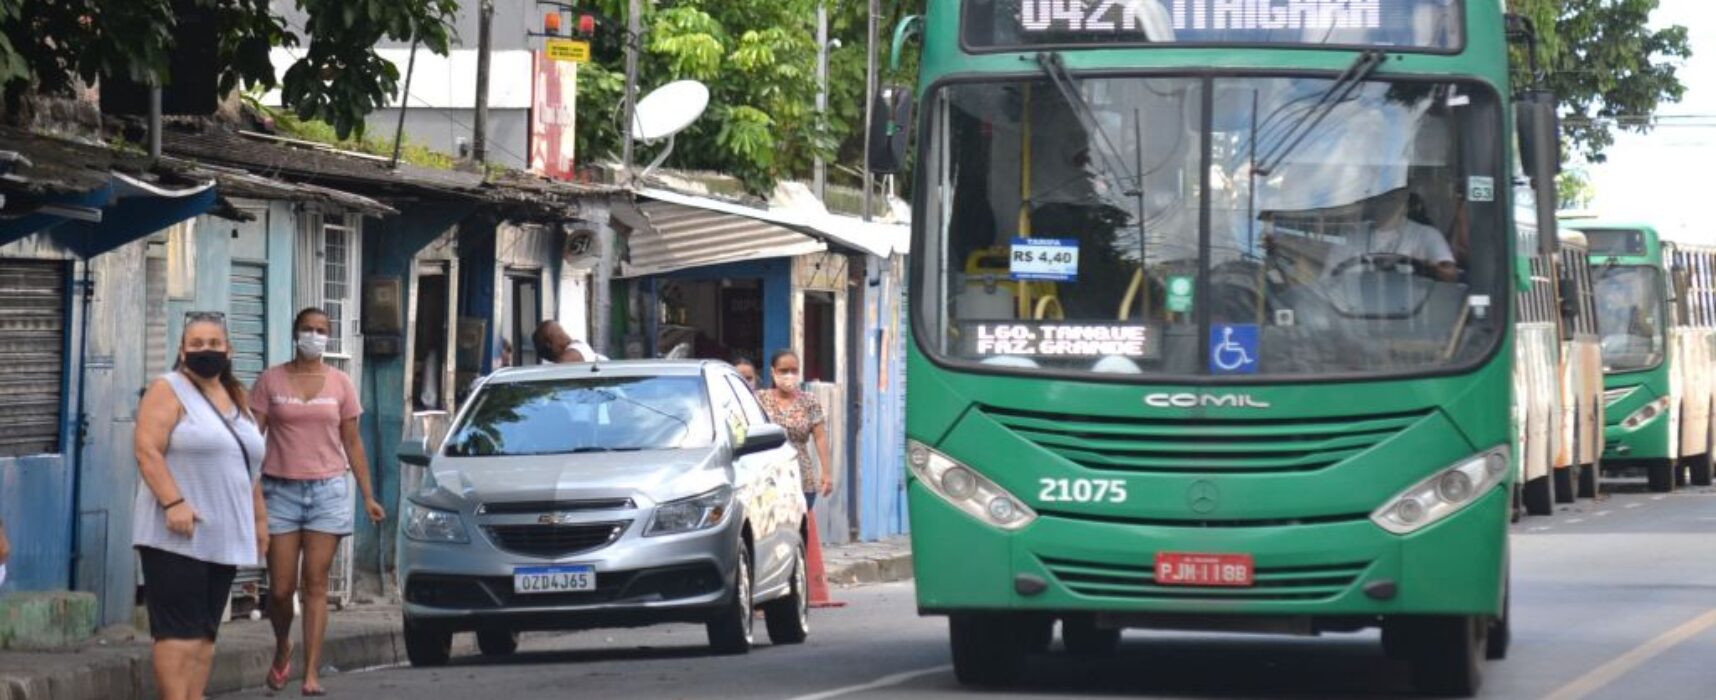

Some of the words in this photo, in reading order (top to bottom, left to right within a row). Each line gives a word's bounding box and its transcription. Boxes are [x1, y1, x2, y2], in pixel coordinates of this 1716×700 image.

[1039, 251, 1072, 264] 4,40
[978, 325, 1036, 340] LGO.
[1039, 326, 1146, 341] TANQUE
[978, 341, 1036, 354] FAZ.
[1039, 341, 1144, 355] GRANDE
[1145, 393, 1270, 407] COMIL
[1039, 478, 1127, 502] 21075
[522, 574, 588, 590] OZD4J65
